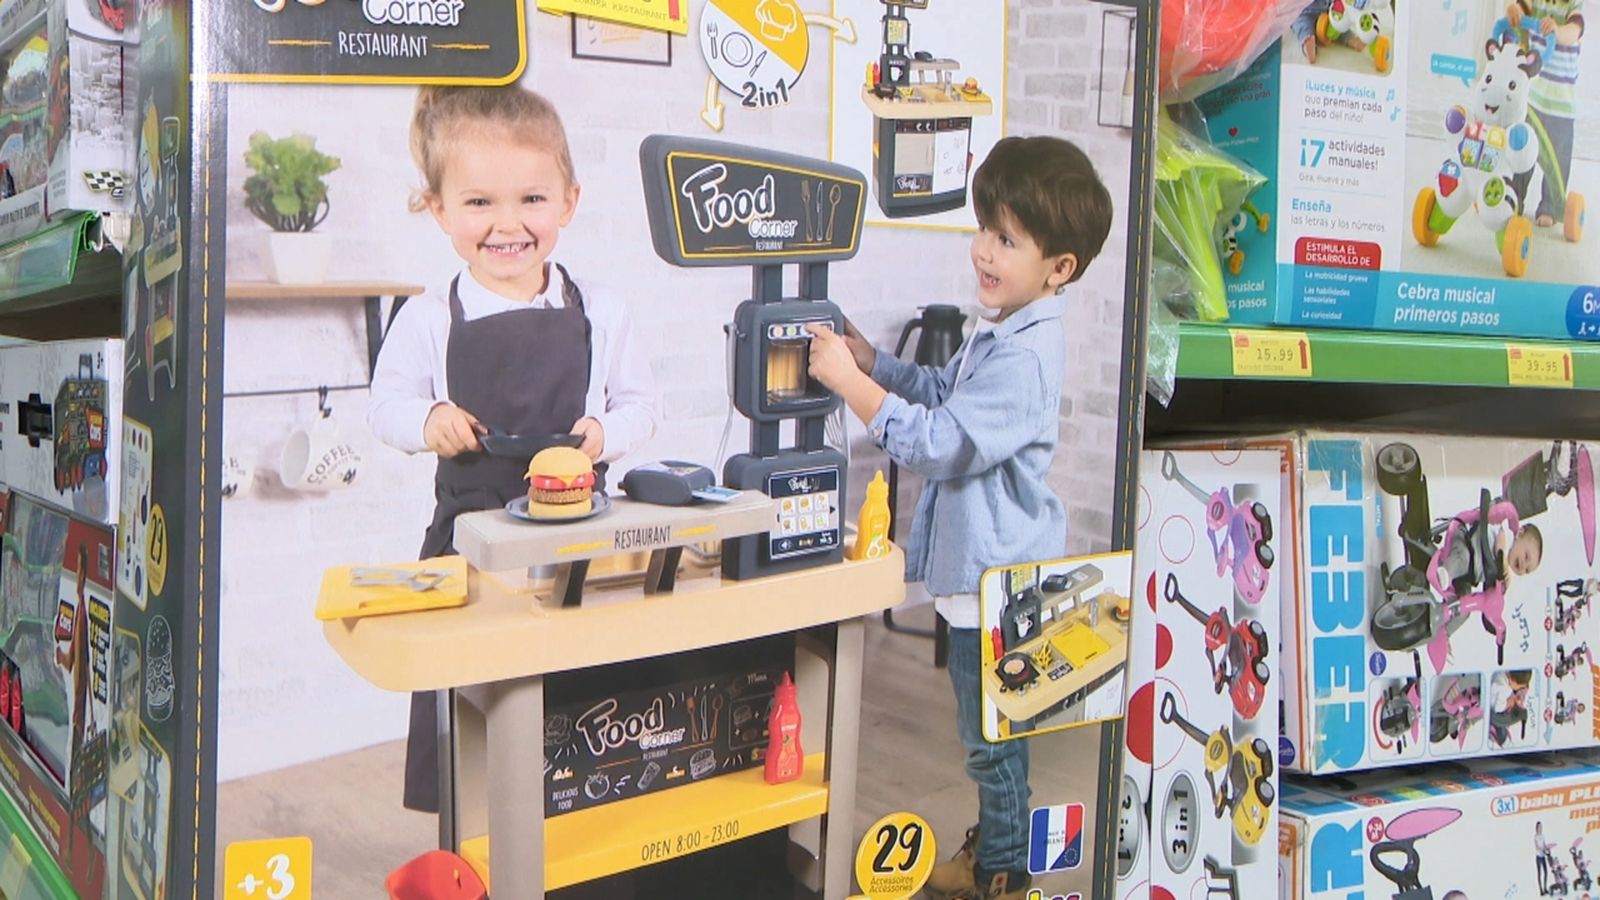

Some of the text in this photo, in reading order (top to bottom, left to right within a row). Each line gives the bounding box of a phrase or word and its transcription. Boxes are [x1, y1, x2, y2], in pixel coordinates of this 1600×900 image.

[612, 4, 667, 20] RESTAURANT
[338, 31, 429, 58] RESTAURANT
[741, 77, 791, 108] 2in1
[1338, 85, 1344, 96] y
[1345, 86, 1376, 99] música
[1304, 108, 1327, 118] paso
[1305, 95, 1382, 113] que premian cada
[1328, 139, 1385, 157] actividades
[1328, 155, 1379, 171] manuales!
[682, 163, 775, 233] Food
[1292, 197, 1332, 213] Enseña
[749, 217, 798, 238] Corner
[1290, 214, 1386, 233] las letras y los números
[1306, 241, 1357, 255] ESTIMULA EL
[1305, 252, 1372, 266] DESARROLLO DE
[1304, 271, 1313, 279] La
[1227, 280, 1265, 293] musical
[1397, 281, 1496, 305] Cebra musical
[1239, 298, 1267, 310] pasos
[1393, 303, 1500, 328] primeros pasos
[1256, 347, 1294, 361] 15.99
[614, 524, 672, 550] RESTAURANT
[1308, 439, 1365, 770] FEBER
[576, 698, 664, 756] Food
[639, 727, 686, 750] Corner
[1497, 796, 1516, 814] 3x1
[1521, 792, 1564, 811] baby
[1172, 789, 1188, 854] 3 in 1
[641, 838, 671, 861] OPEN
[676, 830, 701, 853] 8:00
[711, 820, 739, 843] 23:00
[872, 821, 923, 873] 29
[236, 853, 296, 899] +3
[870, 875, 914, 886] Accessoires
